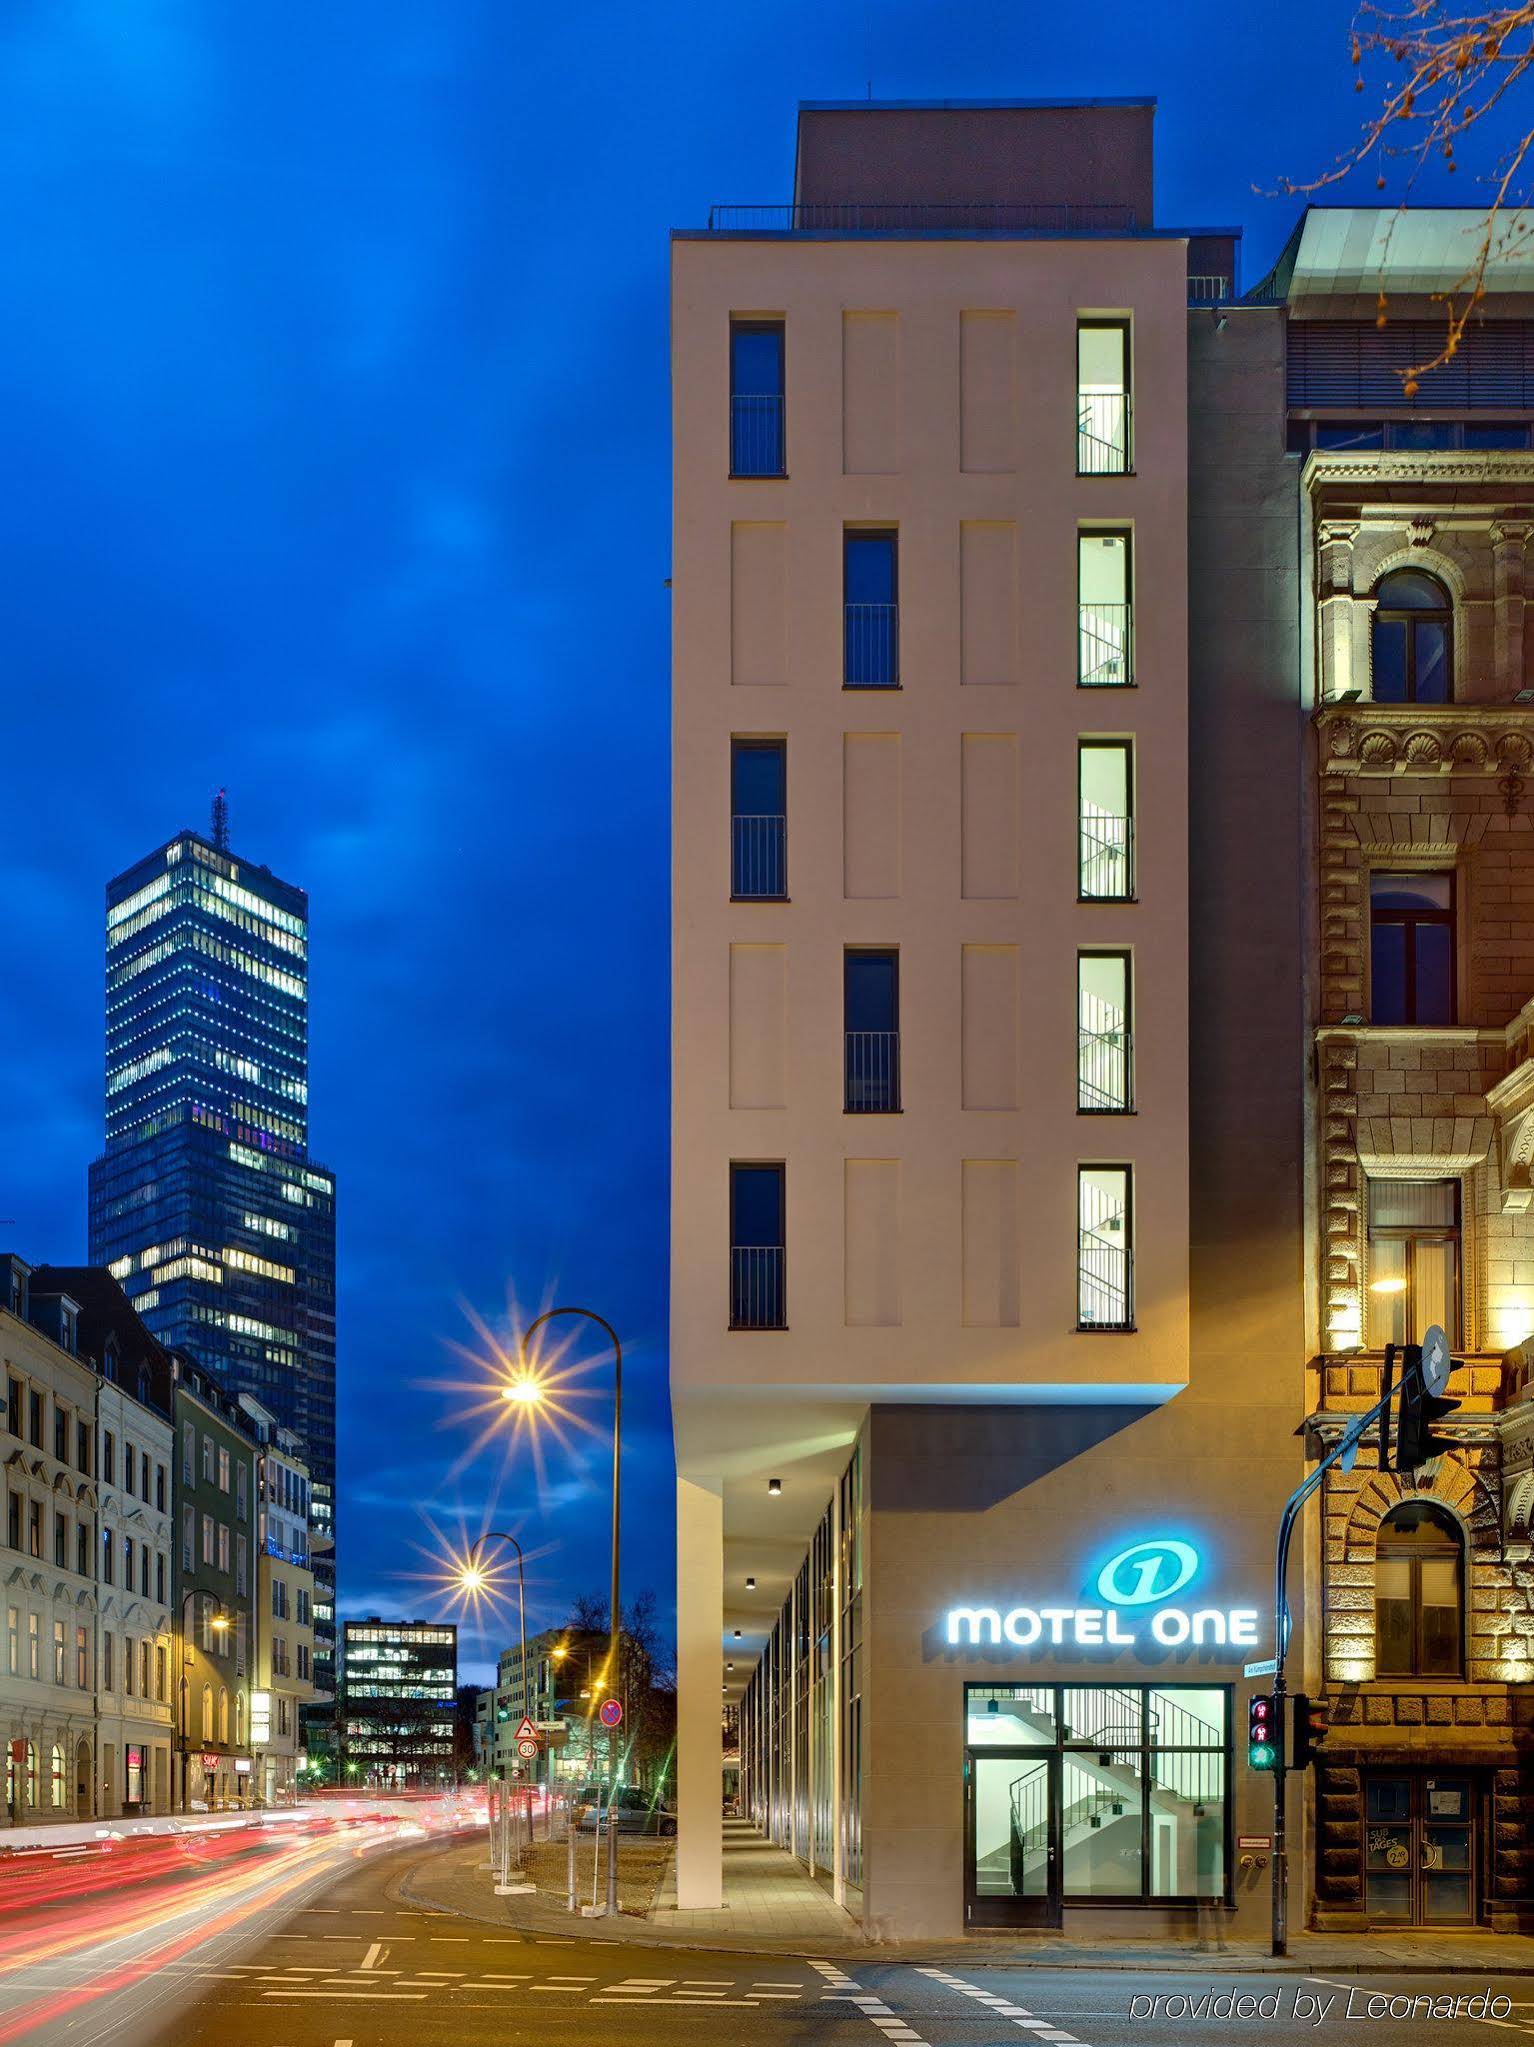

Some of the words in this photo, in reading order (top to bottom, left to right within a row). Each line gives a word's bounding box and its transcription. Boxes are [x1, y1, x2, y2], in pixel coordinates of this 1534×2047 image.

[947, 1607, 1135, 1645] MOTEL
[1151, 1607, 1259, 1646] ONE
[521, 1744, 533, 1754] 30
[1368, 1838, 1398, 1852] TAGES
